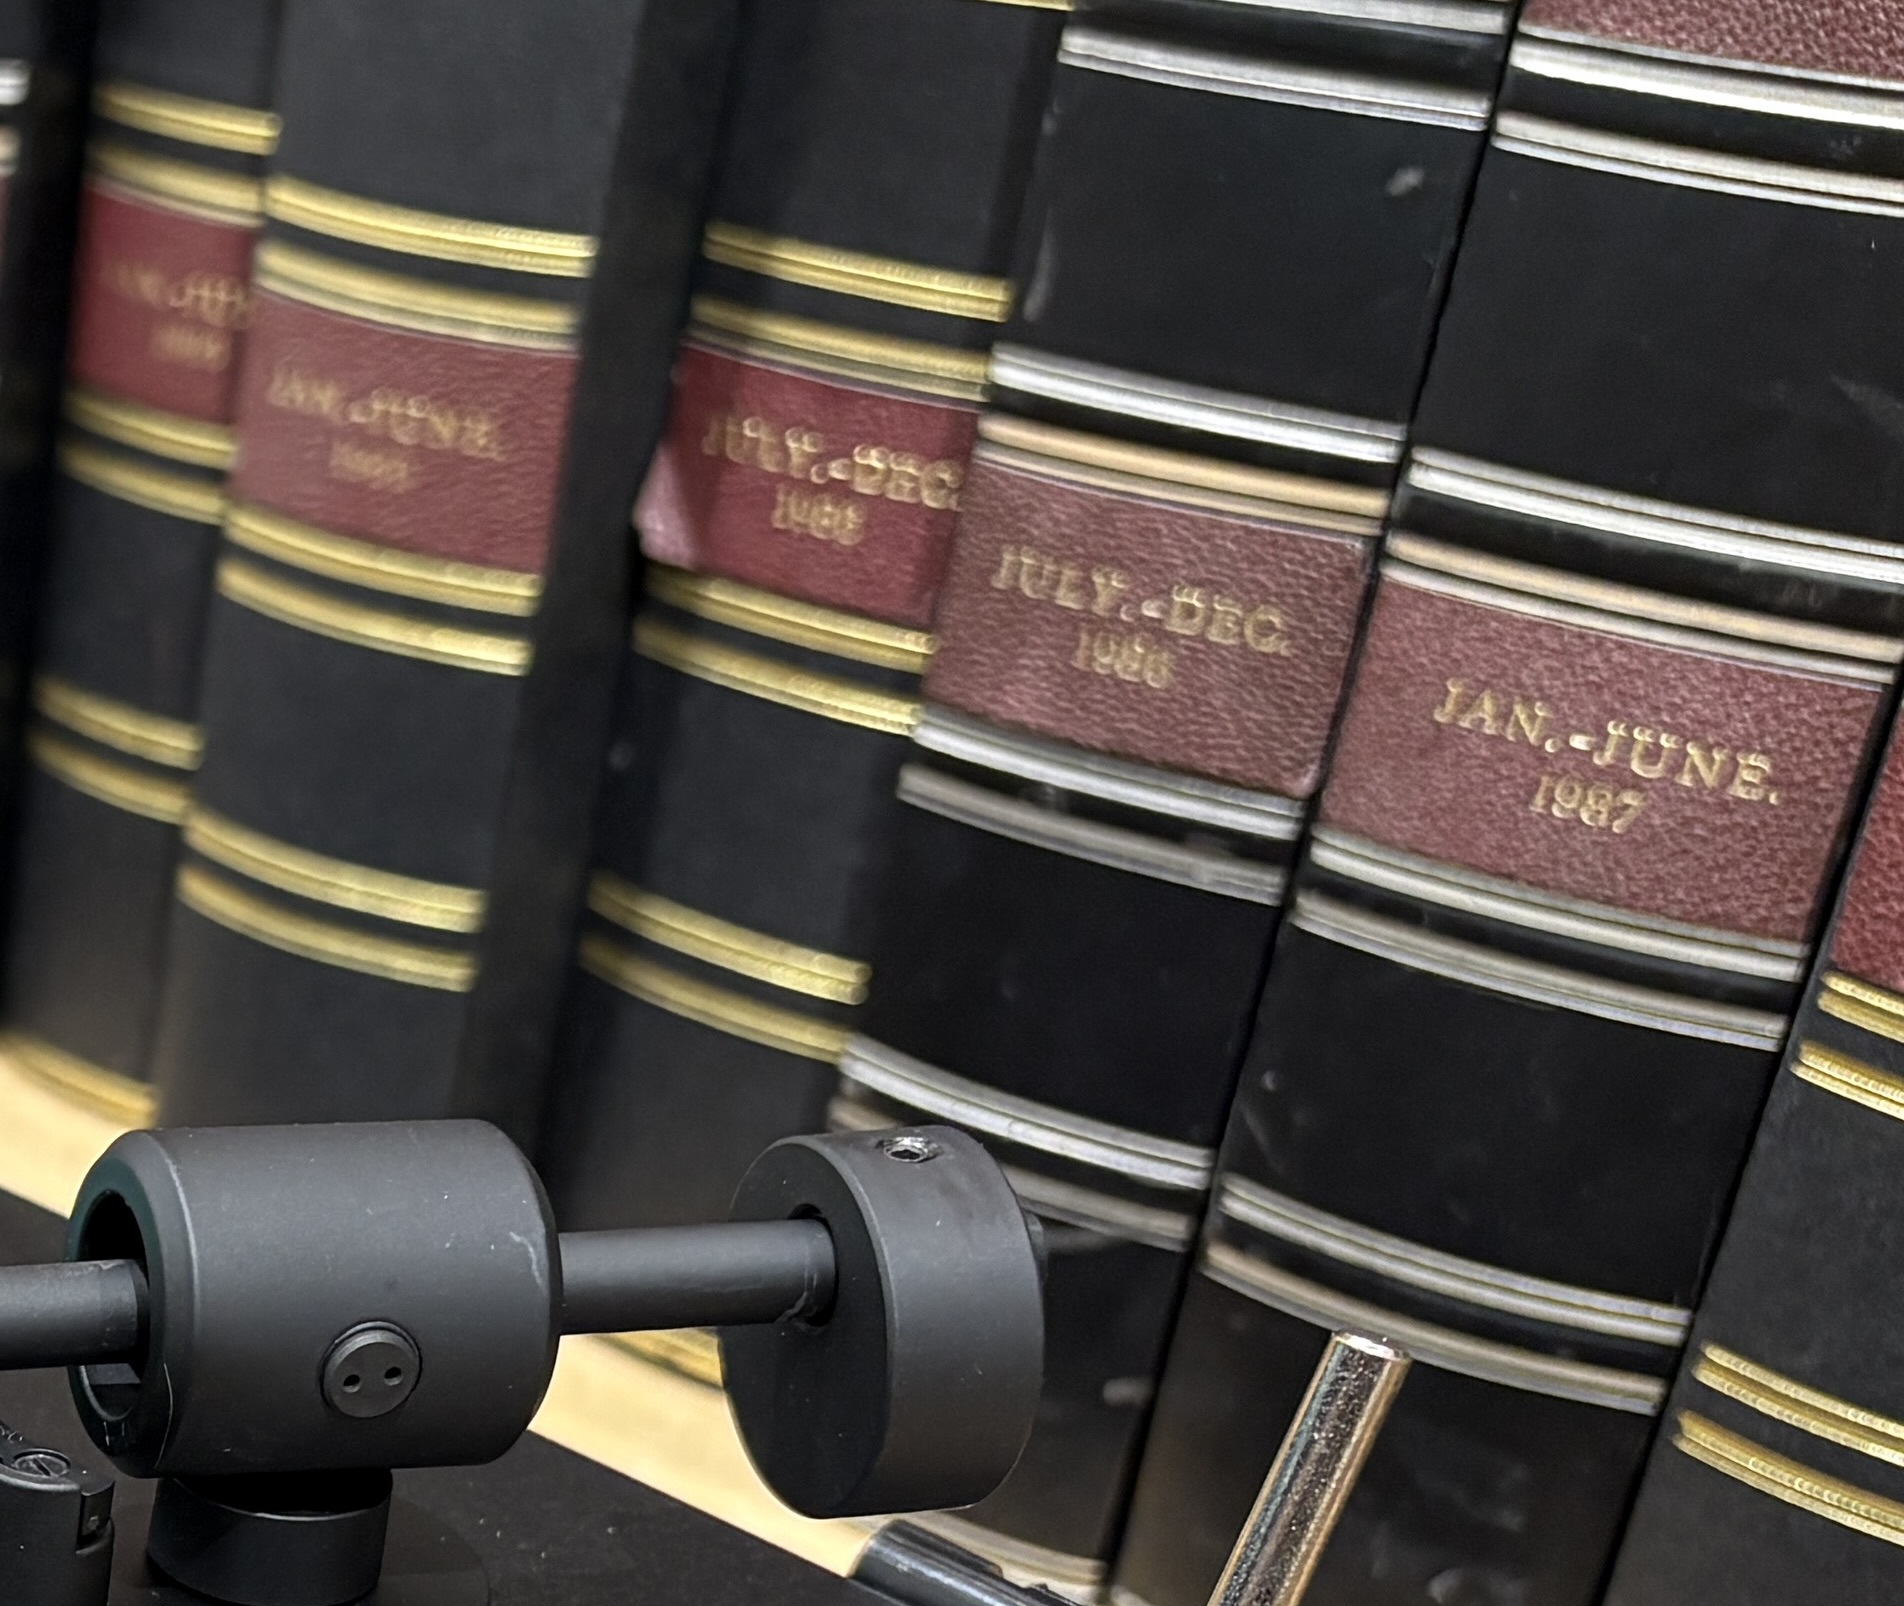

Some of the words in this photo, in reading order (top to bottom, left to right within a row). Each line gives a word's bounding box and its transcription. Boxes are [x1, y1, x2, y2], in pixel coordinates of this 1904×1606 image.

[991, 545, 1293, 656] JULY.-DEC.
[1433, 677, 1780, 805] JAN.-JUNE.
[1529, 774, 1645, 834] 1987
